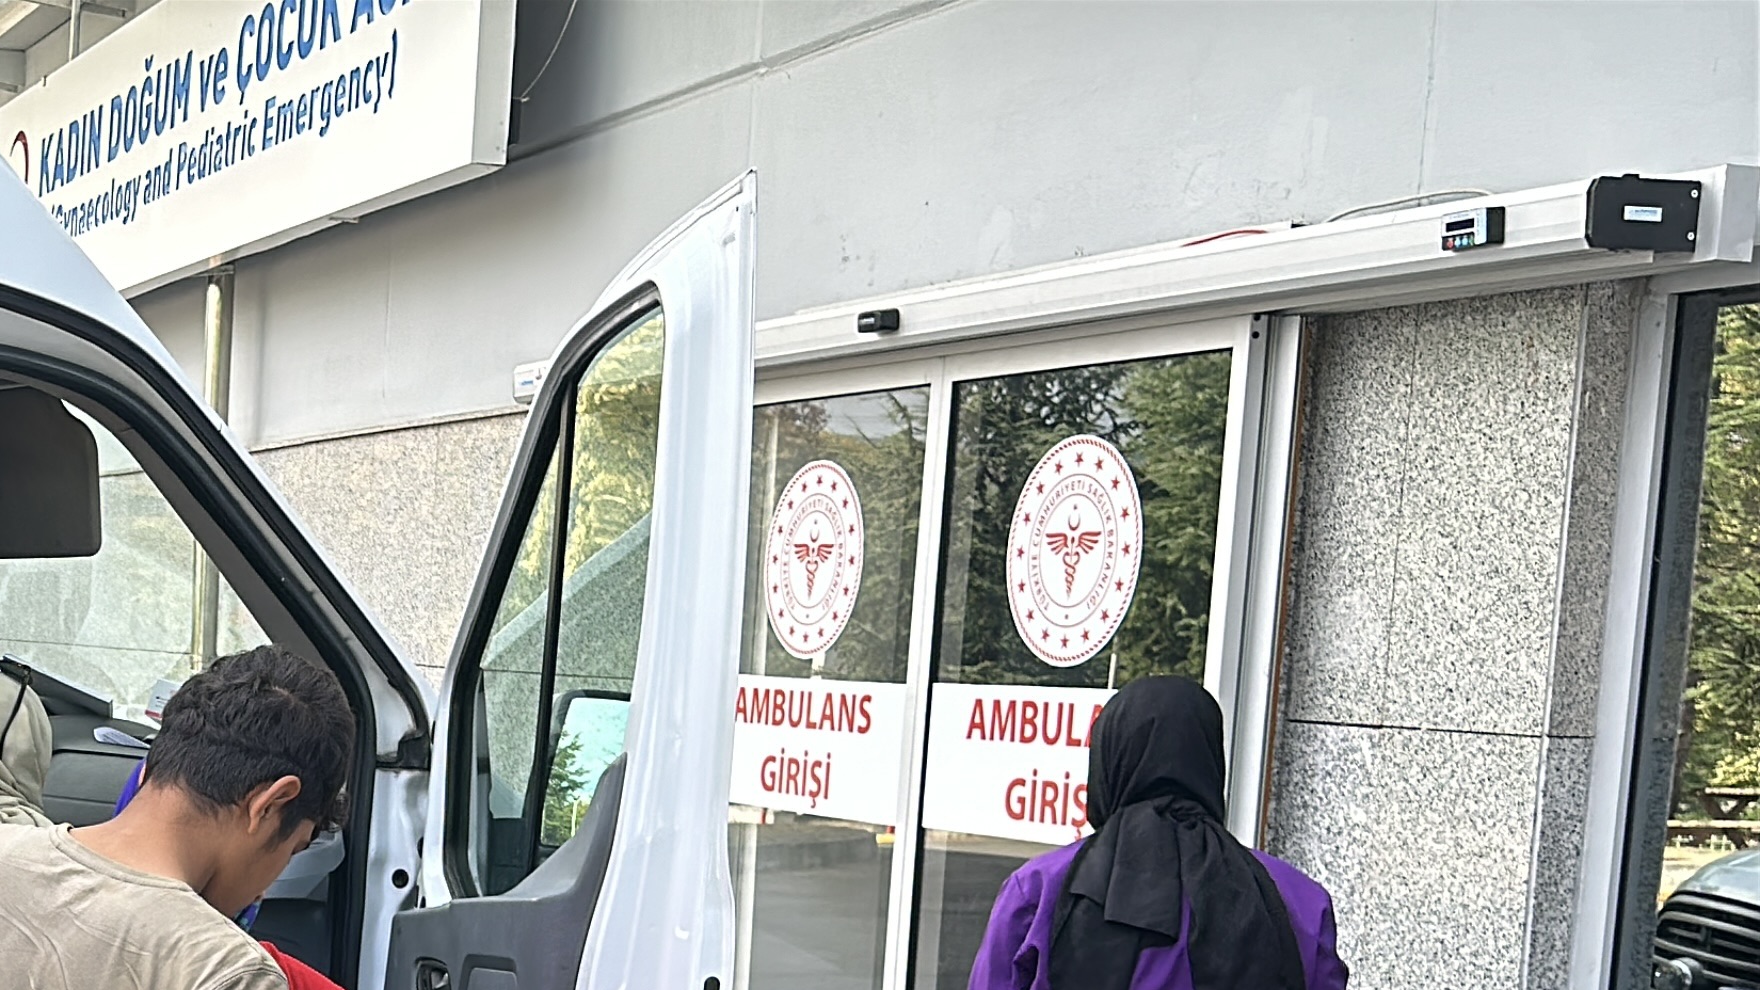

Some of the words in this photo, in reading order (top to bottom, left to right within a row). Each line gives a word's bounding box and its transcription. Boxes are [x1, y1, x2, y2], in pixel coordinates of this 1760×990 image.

[39, 104, 104, 198] KADIN
[107, 50, 192, 163] DOĞUM
[199, 47, 229, 113] ve
[143, 147, 174, 205] and
[175, 110, 258, 191] Pediatric
[261, 28, 398, 151] Emergency)
[735, 686, 873, 735] AMBULANS
[760, 746, 832, 809] GİRİŞİ
